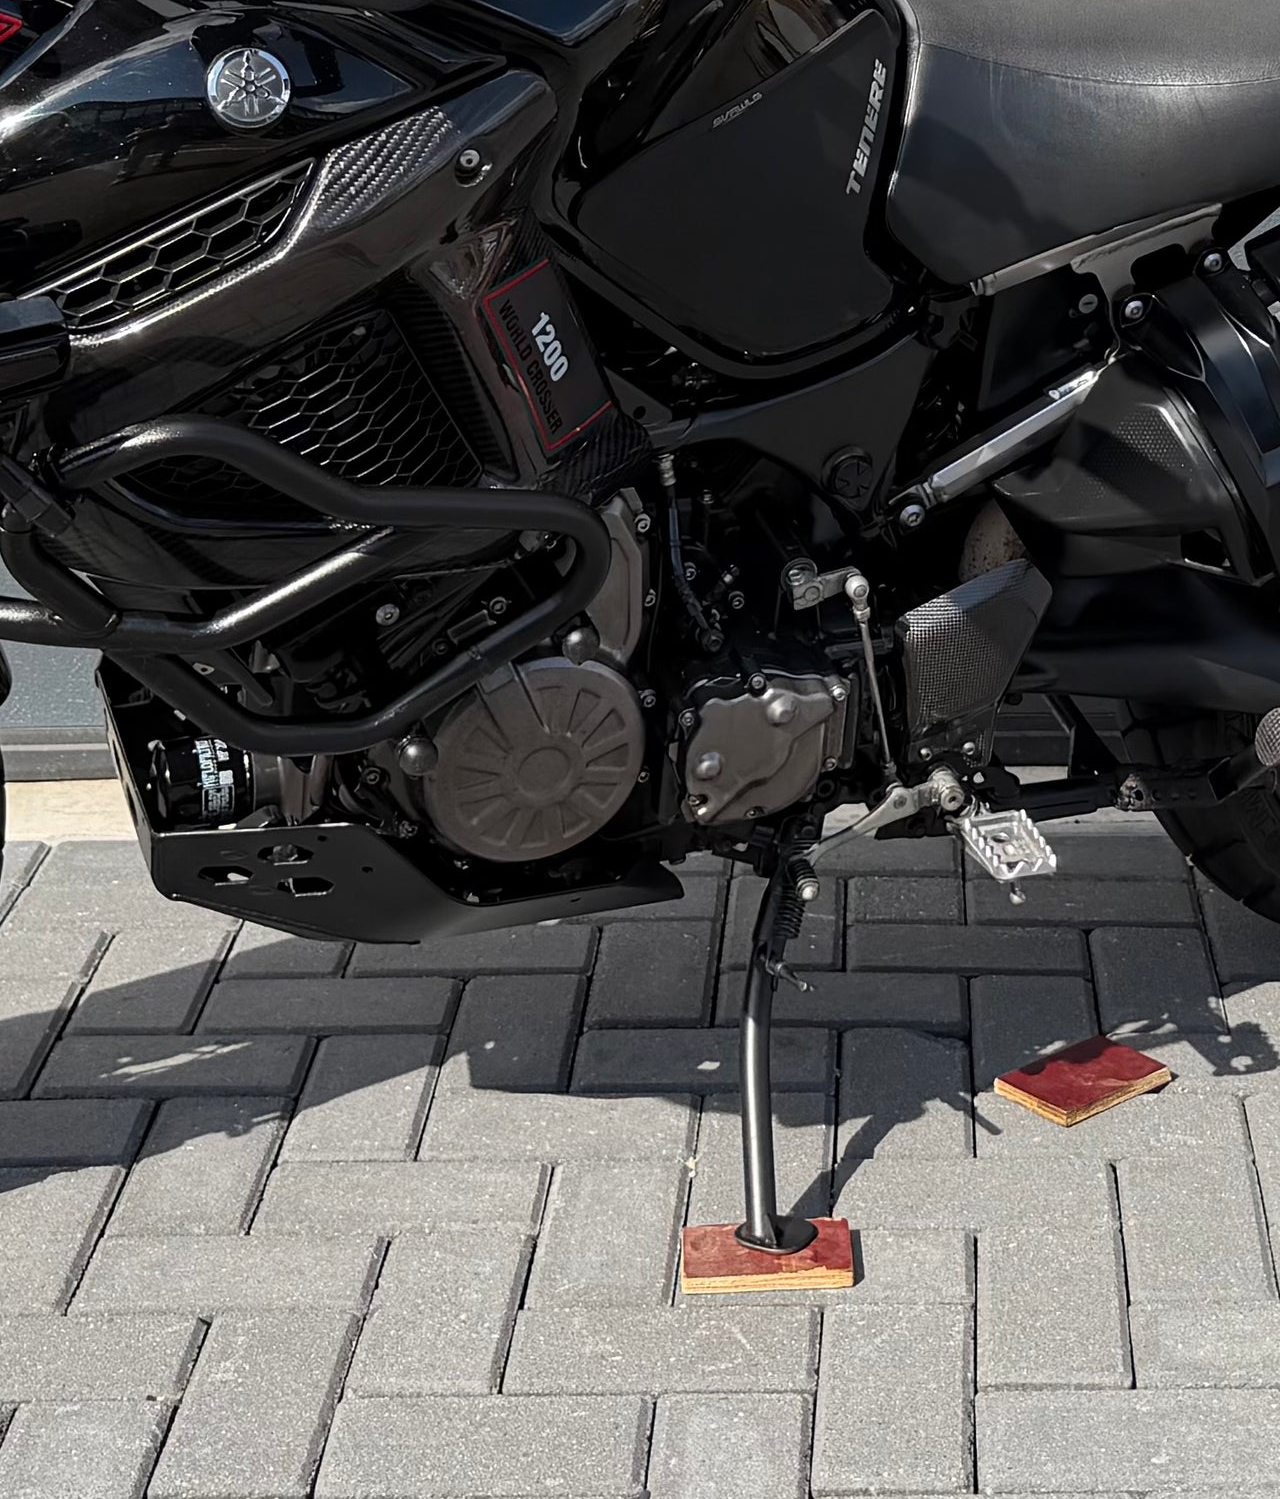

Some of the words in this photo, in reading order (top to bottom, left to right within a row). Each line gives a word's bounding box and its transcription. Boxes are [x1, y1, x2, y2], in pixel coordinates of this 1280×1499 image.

[846, 58, 888, 196] TENERE
[499, 299, 533, 362] WORLD
[526, 357, 564, 435] CROSSER
[531, 311, 570, 383] 1200
